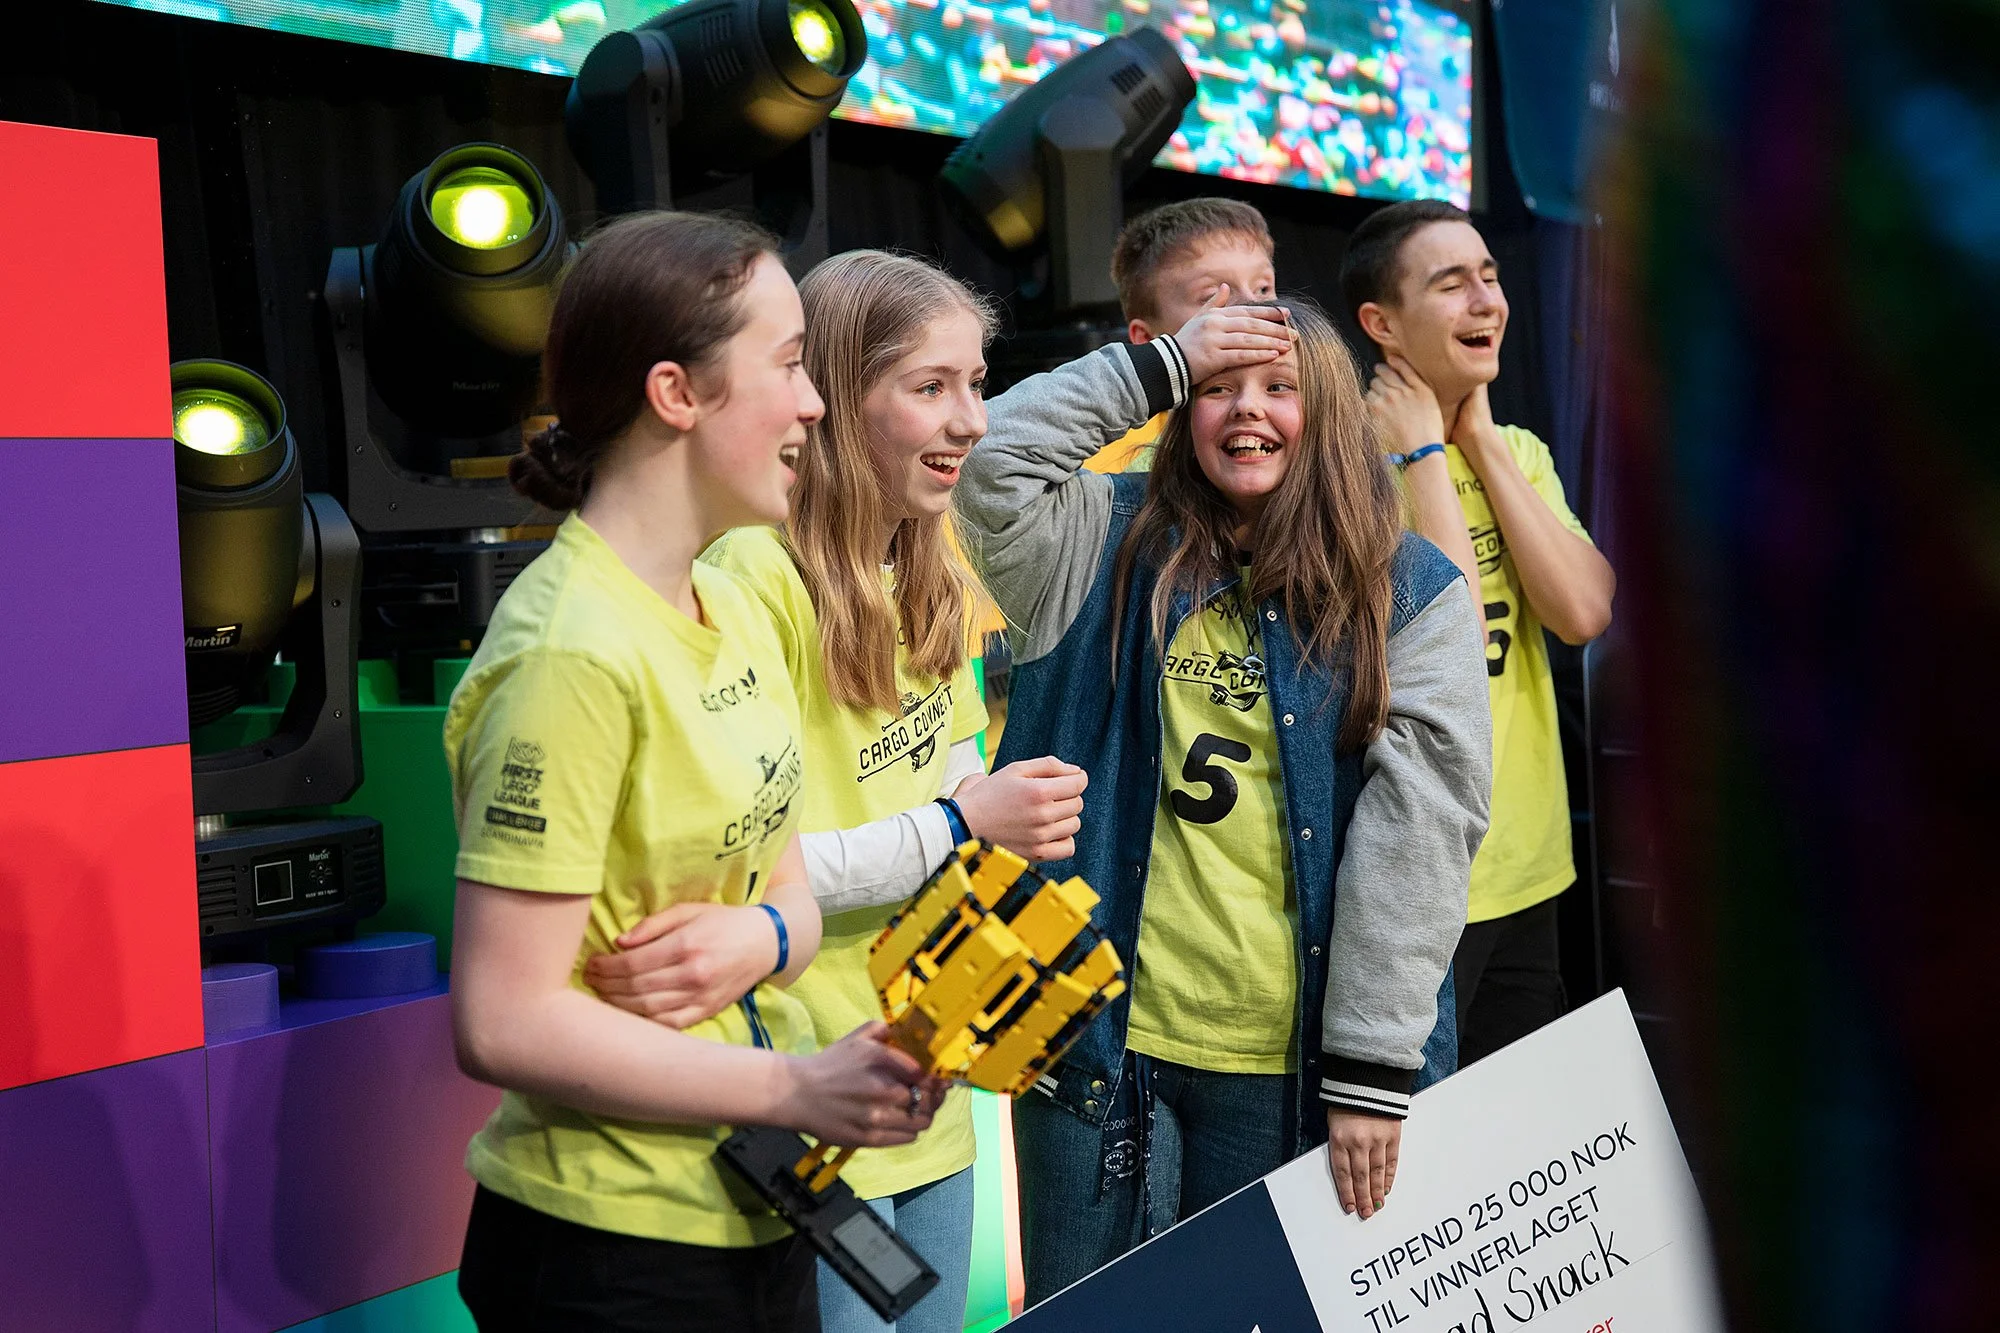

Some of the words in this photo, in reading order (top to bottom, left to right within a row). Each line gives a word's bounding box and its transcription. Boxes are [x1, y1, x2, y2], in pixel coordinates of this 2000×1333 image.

[859, 725, 910, 771] CARGO
[1169, 732, 1252, 825] 5
[494, 788, 541, 810] LEAGUE
[723, 790, 772, 847] CARGO
[308, 850, 329, 862] Martin
[1350, 1217, 1464, 1297] STIPEND
[1468, 1193, 1505, 1232] 25
[1508, 1159, 1567, 1208] 000
[1571, 1121, 1636, 1176] NOK
[1363, 1299, 1410, 1333] TIL
[1409, 1185, 1602, 1309] VINNERLAGET
[1503, 1221, 1631, 1323] Snack
